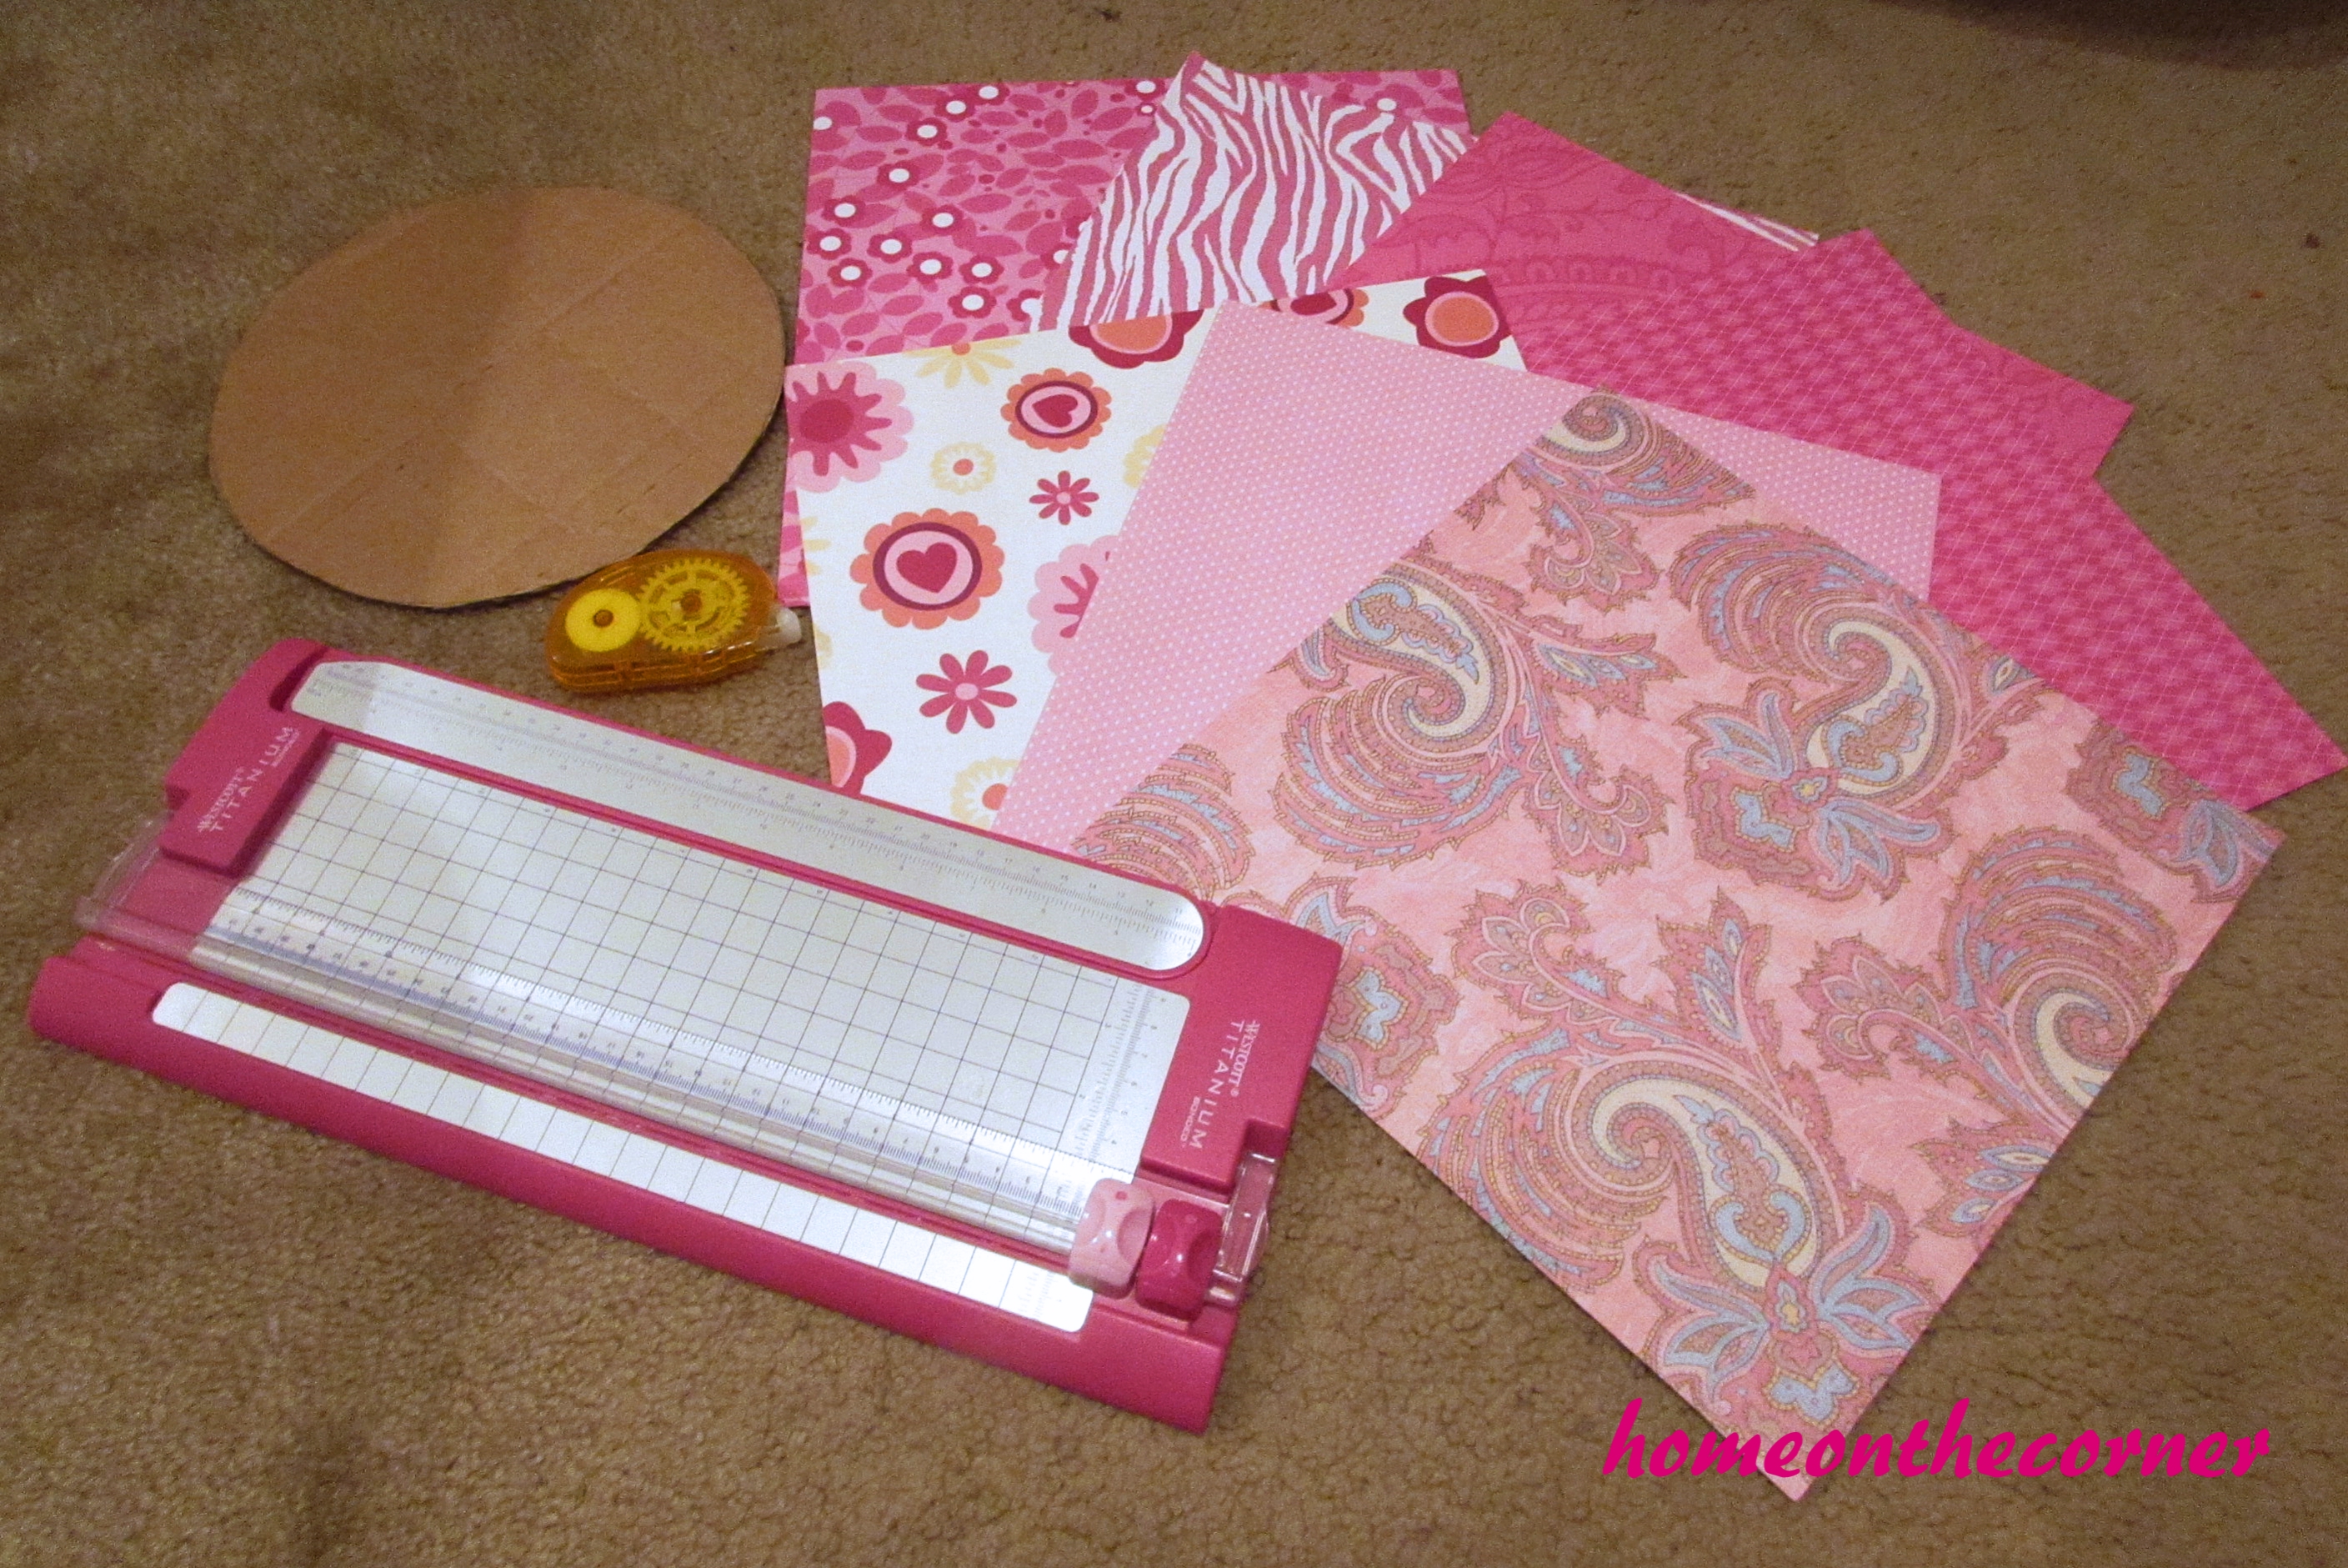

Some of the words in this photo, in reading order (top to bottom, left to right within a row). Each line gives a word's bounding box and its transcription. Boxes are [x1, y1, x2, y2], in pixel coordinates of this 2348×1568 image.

[209, 726, 294, 832] TITANIUM
[1189, 1019, 1245, 1149] TITANIUM
[1234, 1019, 1260, 1088] WESTCOTT
